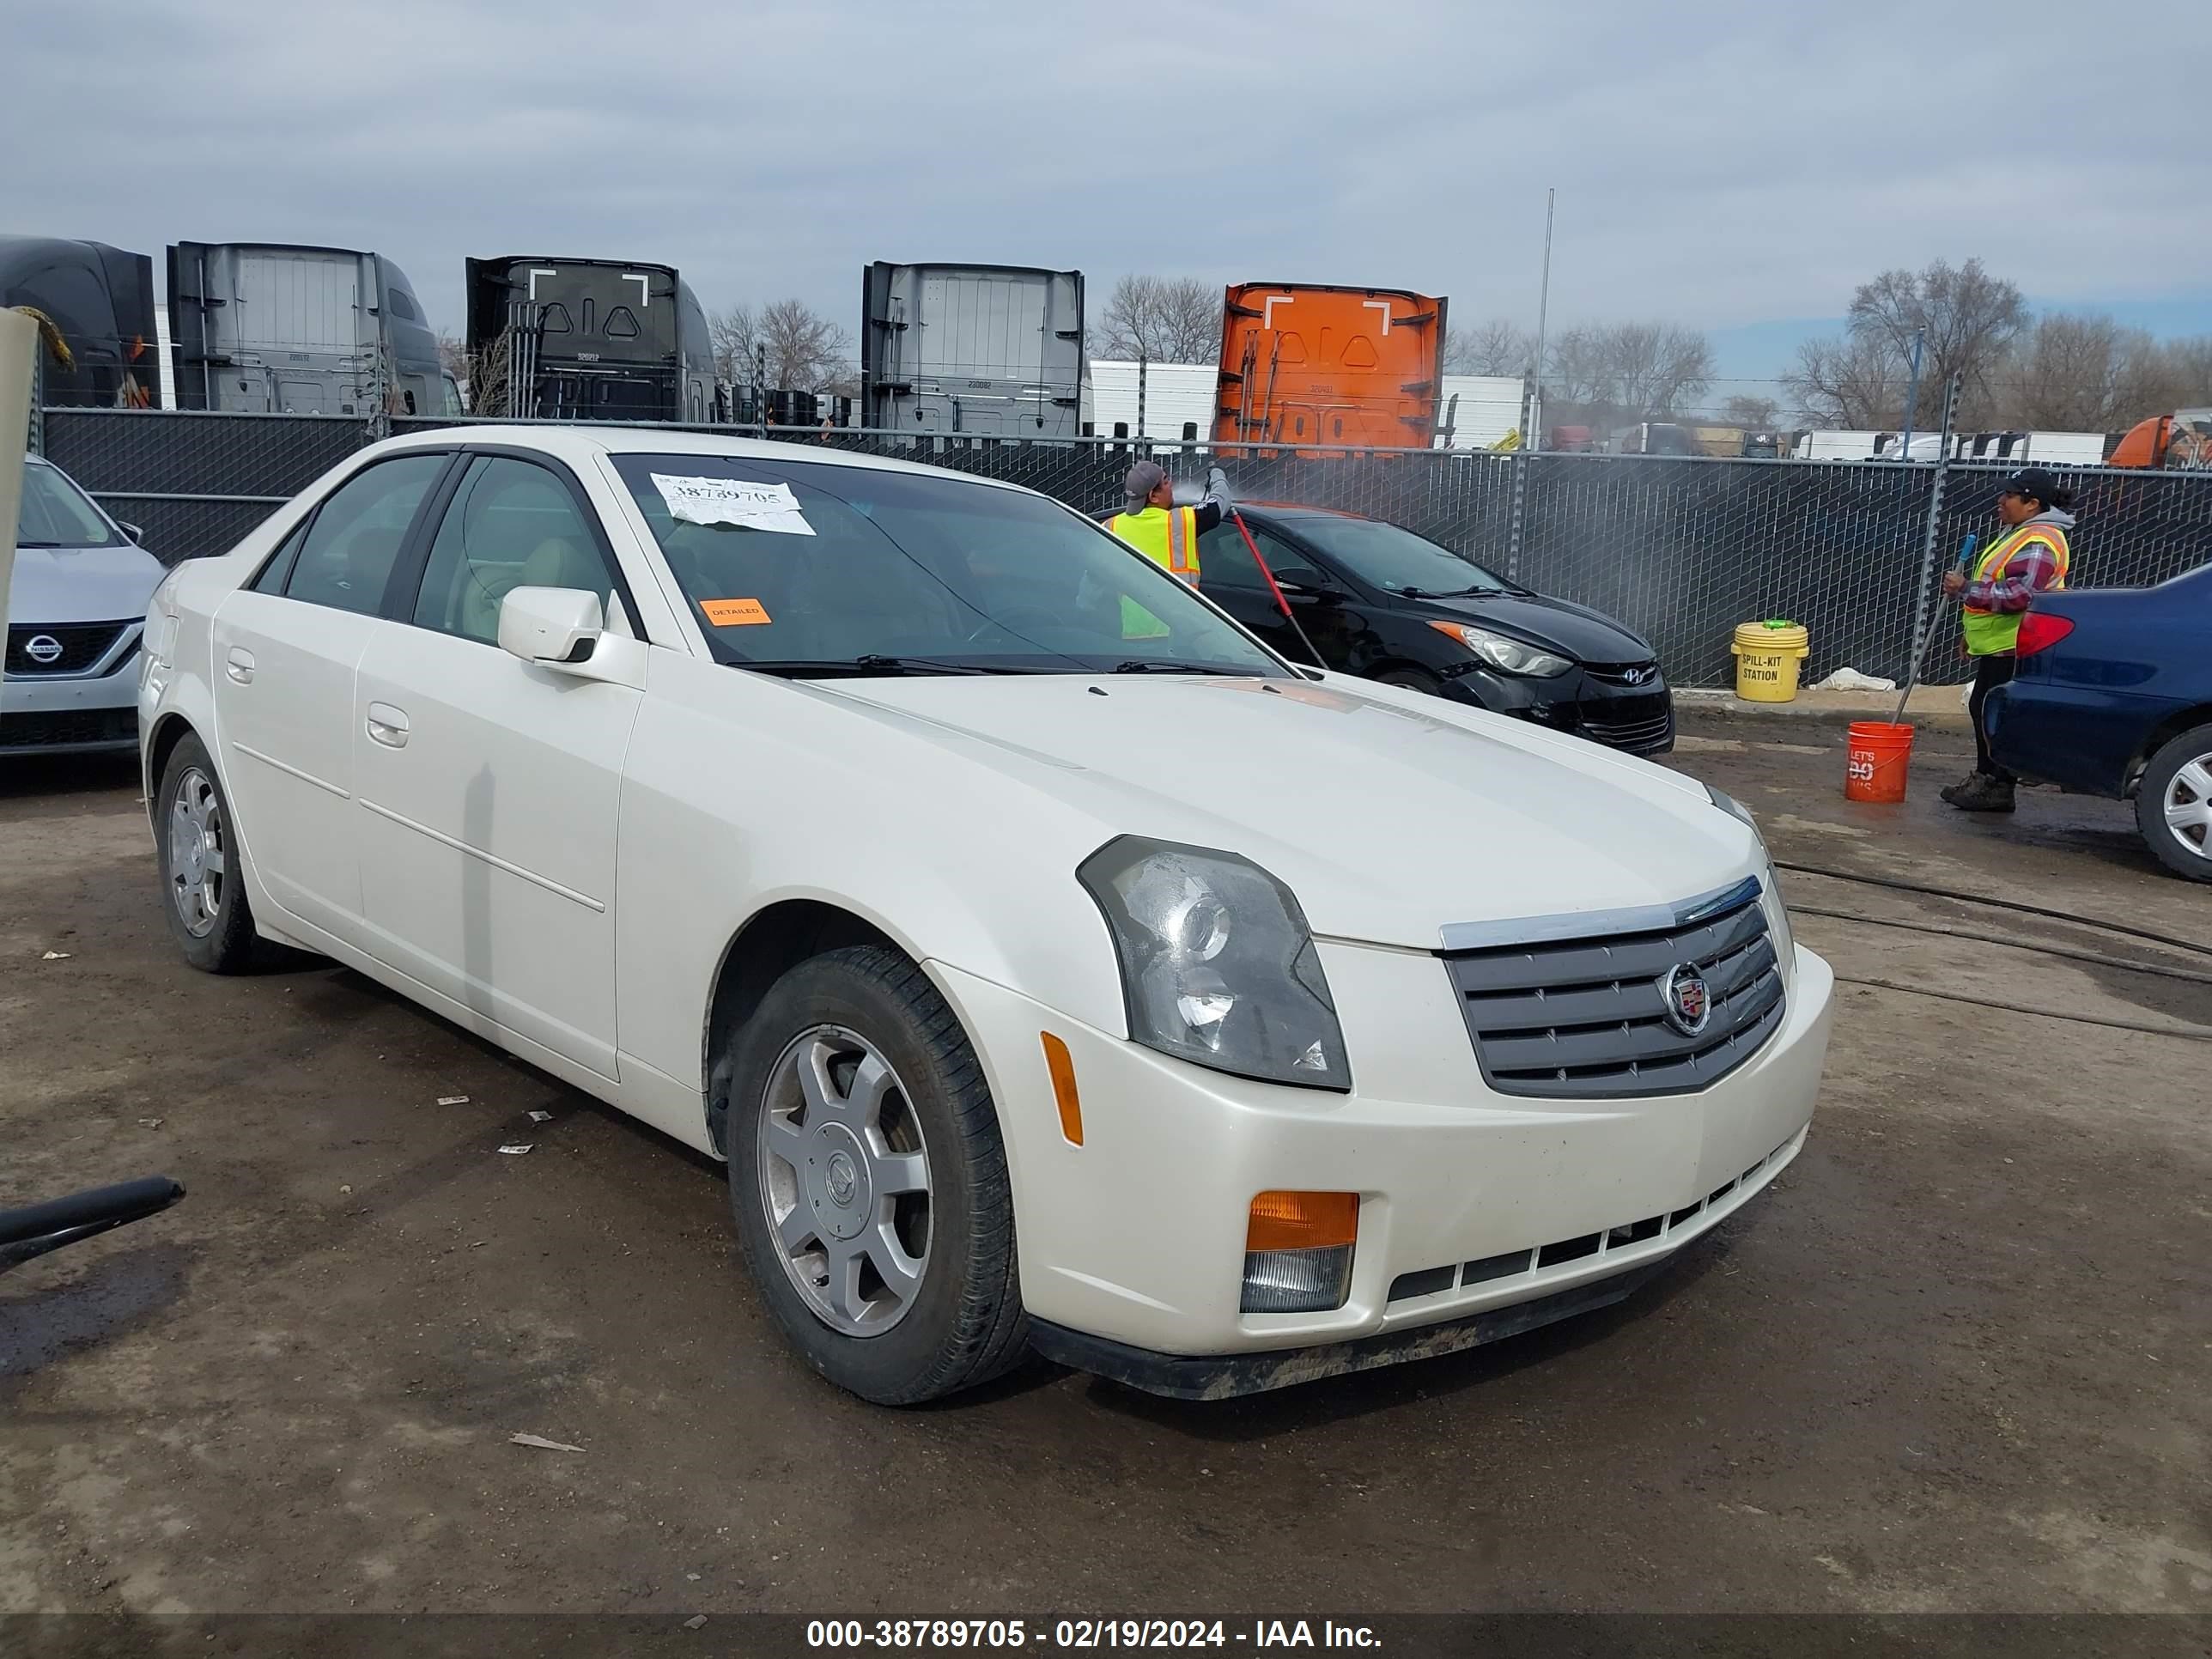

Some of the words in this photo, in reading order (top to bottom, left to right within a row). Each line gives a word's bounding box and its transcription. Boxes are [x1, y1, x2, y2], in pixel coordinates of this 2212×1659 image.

[1742, 653, 1782, 667] SPILL-KIT
[1743, 668, 1778, 681] STATION
[1850, 749, 1875, 762] LET'S
